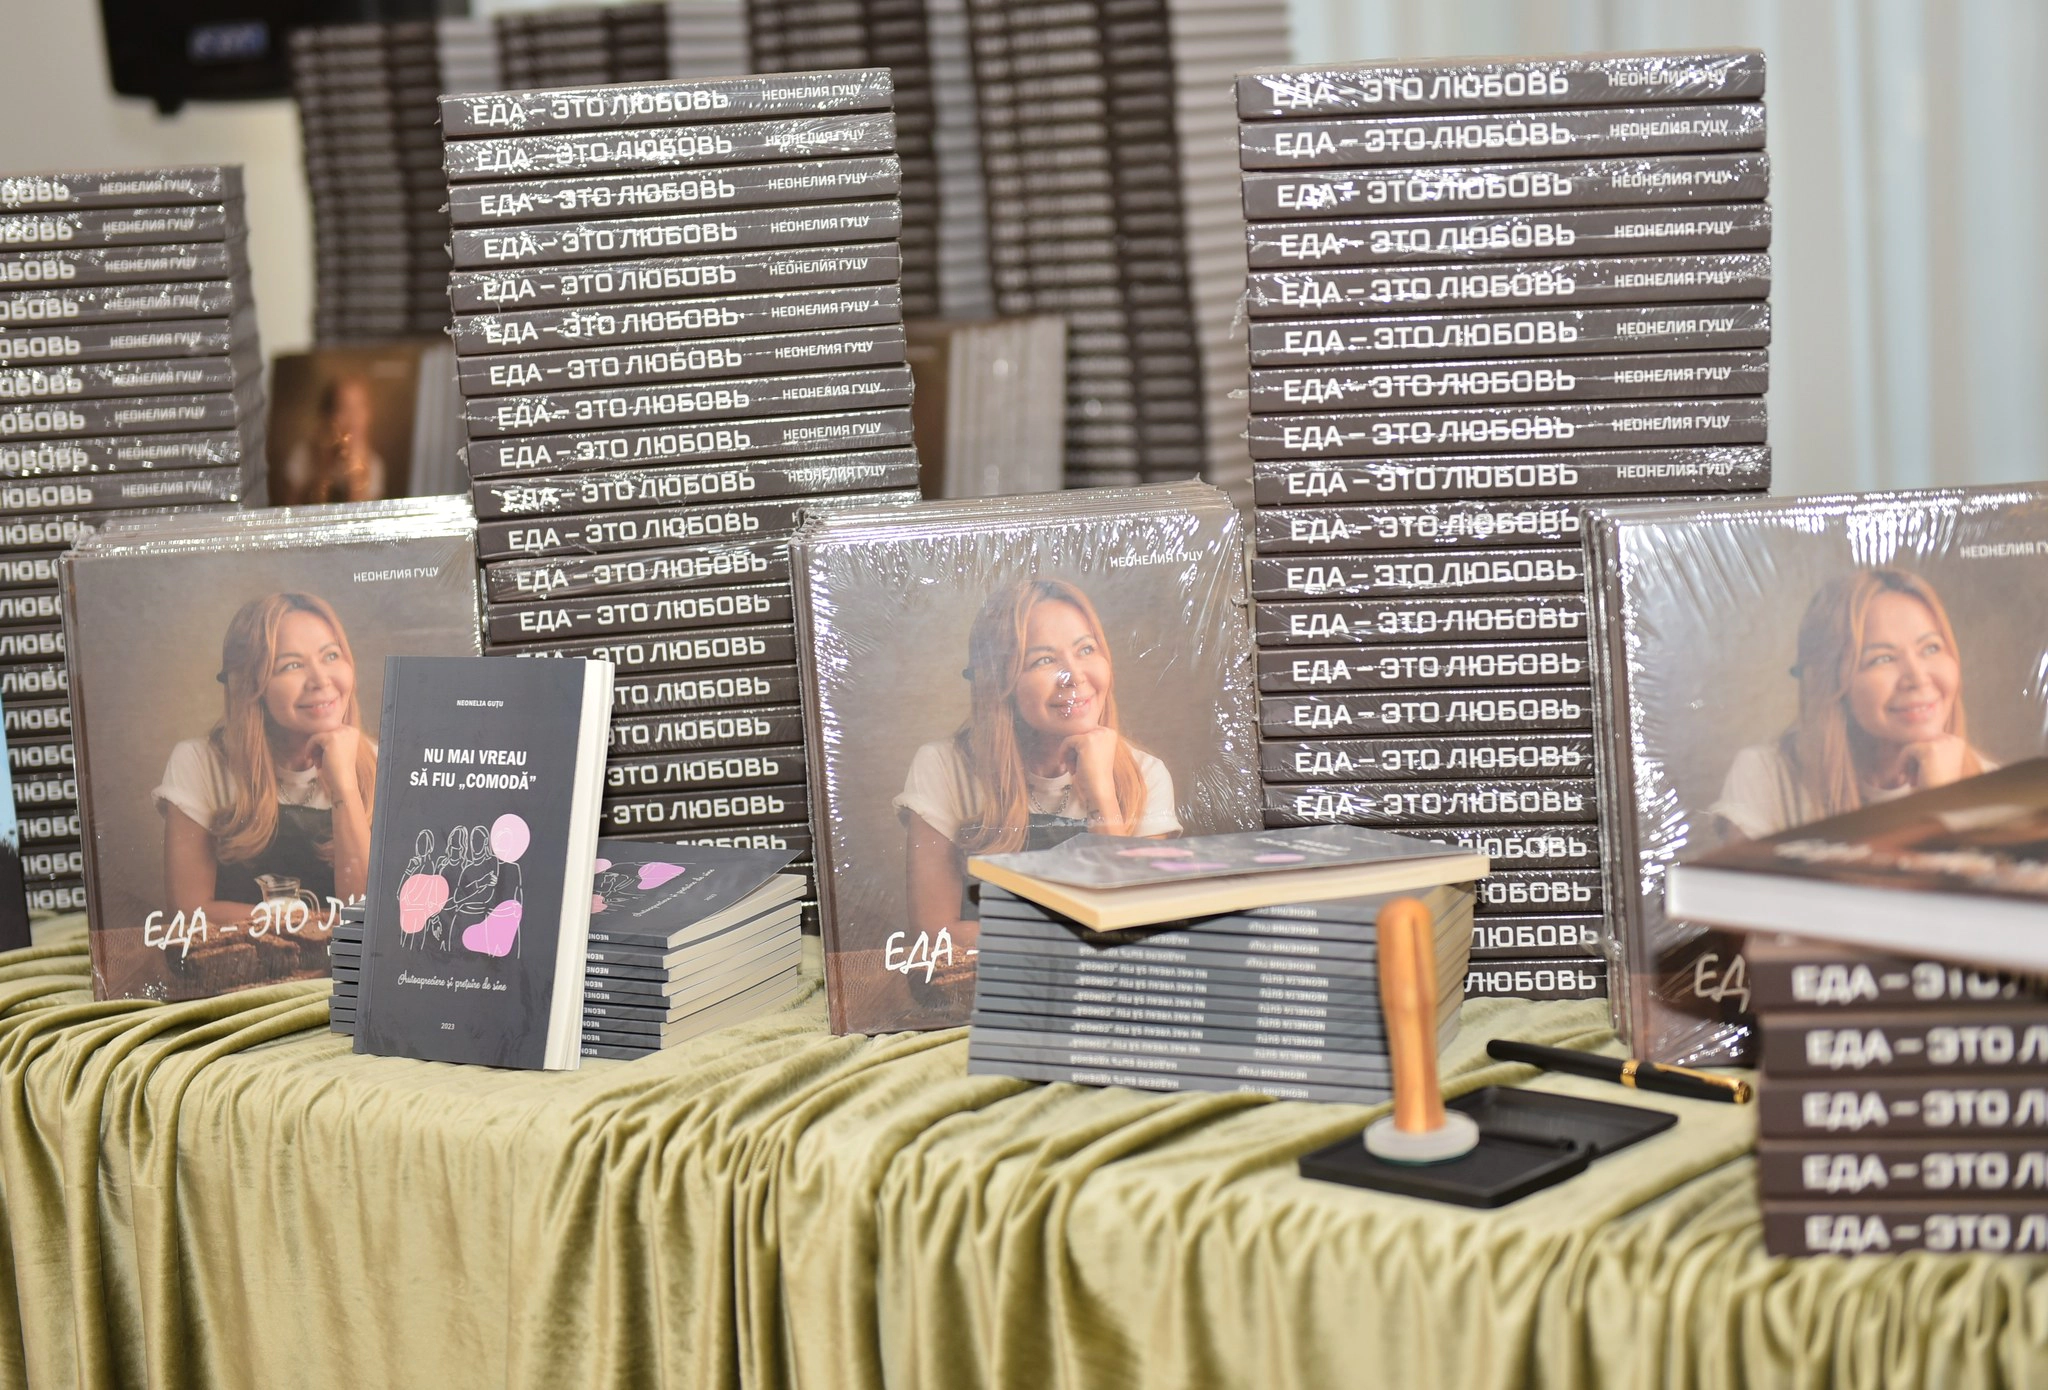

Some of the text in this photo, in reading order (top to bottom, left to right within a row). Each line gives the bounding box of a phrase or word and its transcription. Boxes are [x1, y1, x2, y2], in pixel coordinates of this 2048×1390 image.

[762, 84, 861, 101] НЕОНЕЛИЯ ГУЦУ
[473, 89, 729, 126] ЕДА ЭТО ЛЮБОВЬ
[771, 216, 869, 234] НЕОНЕЛИЯ ГУЦУ
[1614, 219, 1733, 239] НЕОНЕЛИЯ ГУЦУ
[484, 223, 737, 261] ЕДА ЭТО ЛЮБОВЬ
[1281, 223, 1576, 260] ЕДА ЭТО ЛЮБОВЬ
[105, 258, 168, 273] НЕОНЕЛИЯ
[769, 258, 868, 276] НЕОНЕЛИЯ ГУЦУ
[484, 265, 736, 303] ЕДА ЭТО ЛЮБОВЬ
[771, 301, 870, 319] НЕОНЕЛИЯ ГУЦУ
[487, 307, 739, 346] ЕДА ЭТО ЛЮБОВЬ
[1285, 321, 1578, 356] ЕДА ЭТО ЛЮБОВЬ
[1616, 317, 1734, 337] НЕОНЕЛИЯ ГУЦУ
[110, 334, 172, 349] НЕОНЕЛИЯ
[775, 341, 874, 359] НЕОНЕЛИЯ ГУЦУ
[490, 349, 742, 386] ЕДА ЭТО ЛЮБОВЬ
[1614, 366, 1731, 386] НЕОНЕЛИЯ ГУЦУ
[782, 383, 881, 401] НЕОНЕЛИЯ ГУЦУ
[1283, 369, 1576, 404] ЕДА ЭТО ЛЮБОВЬ
[115, 408, 177, 423] НЕОНЕЛИЯ
[498, 390, 750, 428] ЕДА ЭТО ЛЮБОВЬ
[1613, 414, 1730, 433] НЕОНЕЛИЯ ГУЦУ
[784, 423, 881, 441] НЕОНЕЛИЯ ГУЦУ
[1283, 416, 1575, 451] ЕДА ЭТО ЛЮБОВЬ
[118, 445, 179, 459] НЕОНЕЛИЯ
[500, 430, 751, 468] ЕДА ЭТО ЛЮБОВЬ
[1289, 463, 1579, 497] ЕДА ЭТО ЛЮБОВЬ
[1617, 461, 1733, 479] НЕОНЕЛИЯ ГУЦУ
[122, 482, 184, 498] НЕОНЕЛИЯ
[509, 512, 759, 551] ЕДА ЭТО ЛЮБОВЬ
[1110, 552, 1173, 568] НЕОНЕЛИЯ
[1960, 542, 2034, 559] НЕОНЕЛИЯ
[354, 567, 439, 583] НЕОНЕЛИЯ ГУЦУ
[517, 553, 767, 592] ЕДА ЭТО ЛЮБОВЬ
[1287, 559, 1576, 591] ЕДА ЭТО ЛЮБОВЬ
[520, 594, 770, 633] ЕДА ЭТО ЛЮБОВЬ
[1290, 607, 1579, 638] ЕДА ЭТО ЛЮБОВЬ
[651, 637, 766, 663] ЛЮБОВЬ
[1293, 653, 1580, 684] ЕДА ЭТО ЛЮБОВЬ
[614, 677, 771, 705] ТО ЛЮБОВЬ
[1295, 699, 1581, 729] ЕДА ЭТО ЛЮБОВЬ
[655, 717, 771, 743] ЛЮБОВЬ
[424, 748, 527, 765] NU MAI VREAU
[1296, 746, 1581, 775] ЕДА ЭТО ЛЮБОВЬ
[410, 768, 428, 787] SĂ
[432, 772, 455, 787] FIU
[608, 758, 779, 786] ЭТО ЛЮБОВЬ
[613, 795, 784, 825] ЭТО ЛЮБОВЬ
[144, 907, 207, 958] ЕДА
[249, 899, 309, 938] ЭТО
[885, 927, 952, 983] ЕДА
[482, 977, 491, 990] de
[492, 981, 507, 991] sine
[1464, 970, 1597, 993] ЛЮБОВЬ
[1694, 954, 1751, 1014] ЕД
[1791, 963, 1879, 1005] ЕДА
[1805, 1028, 1893, 1070] ЕДА
[1926, 1026, 2014, 1065] ЭТО
[1802, 1091, 1889, 1131] ЕДА
[1922, 1089, 2010, 1129] ЭТО
[1802, 1153, 1889, 1193] ЕДА
[1922, 1152, 2010, 1191] ЭТО
[1804, 1214, 1891, 1254] ЕДА
[1924, 1213, 2012, 1251] ЭТО
